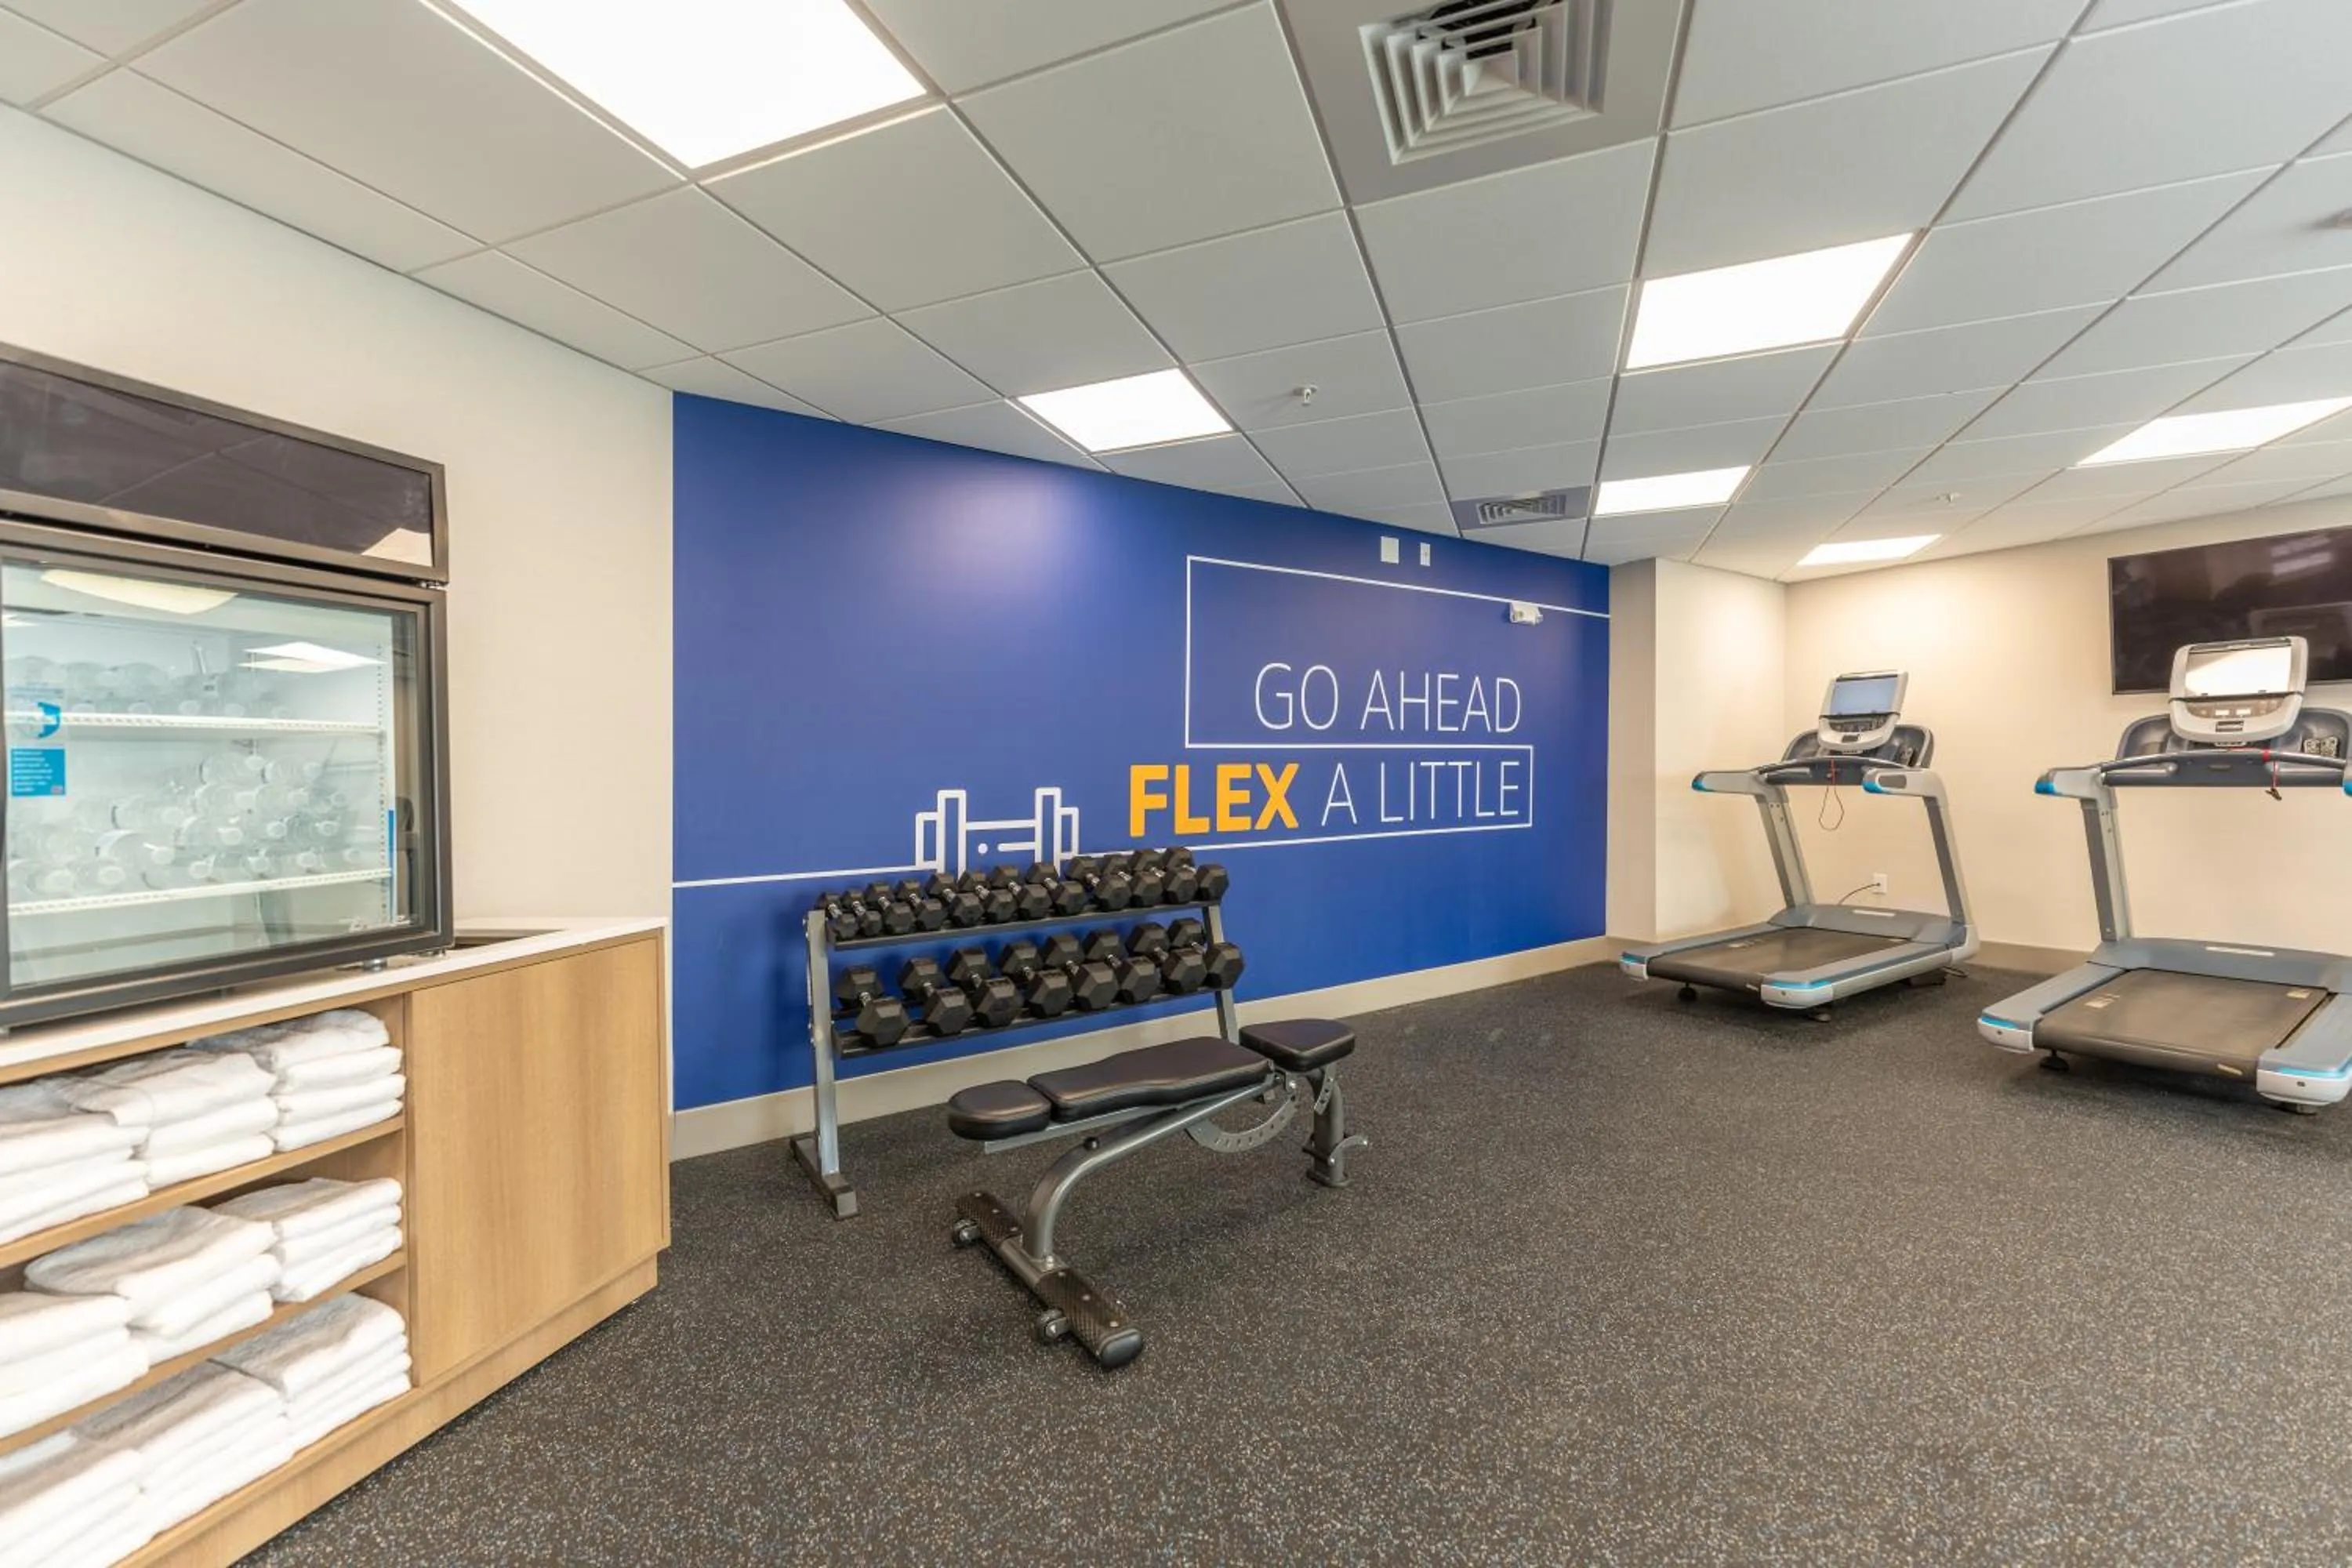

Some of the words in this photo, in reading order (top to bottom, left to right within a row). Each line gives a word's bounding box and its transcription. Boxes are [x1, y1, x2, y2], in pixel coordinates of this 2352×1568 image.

[1255, 662, 1338, 730] GO
[1360, 670, 1521, 733] AHEAD
[1130, 763, 1299, 837] FLEX
[1321, 763, 1357, 826] A
[1381, 761, 1519, 822] LITTLE
